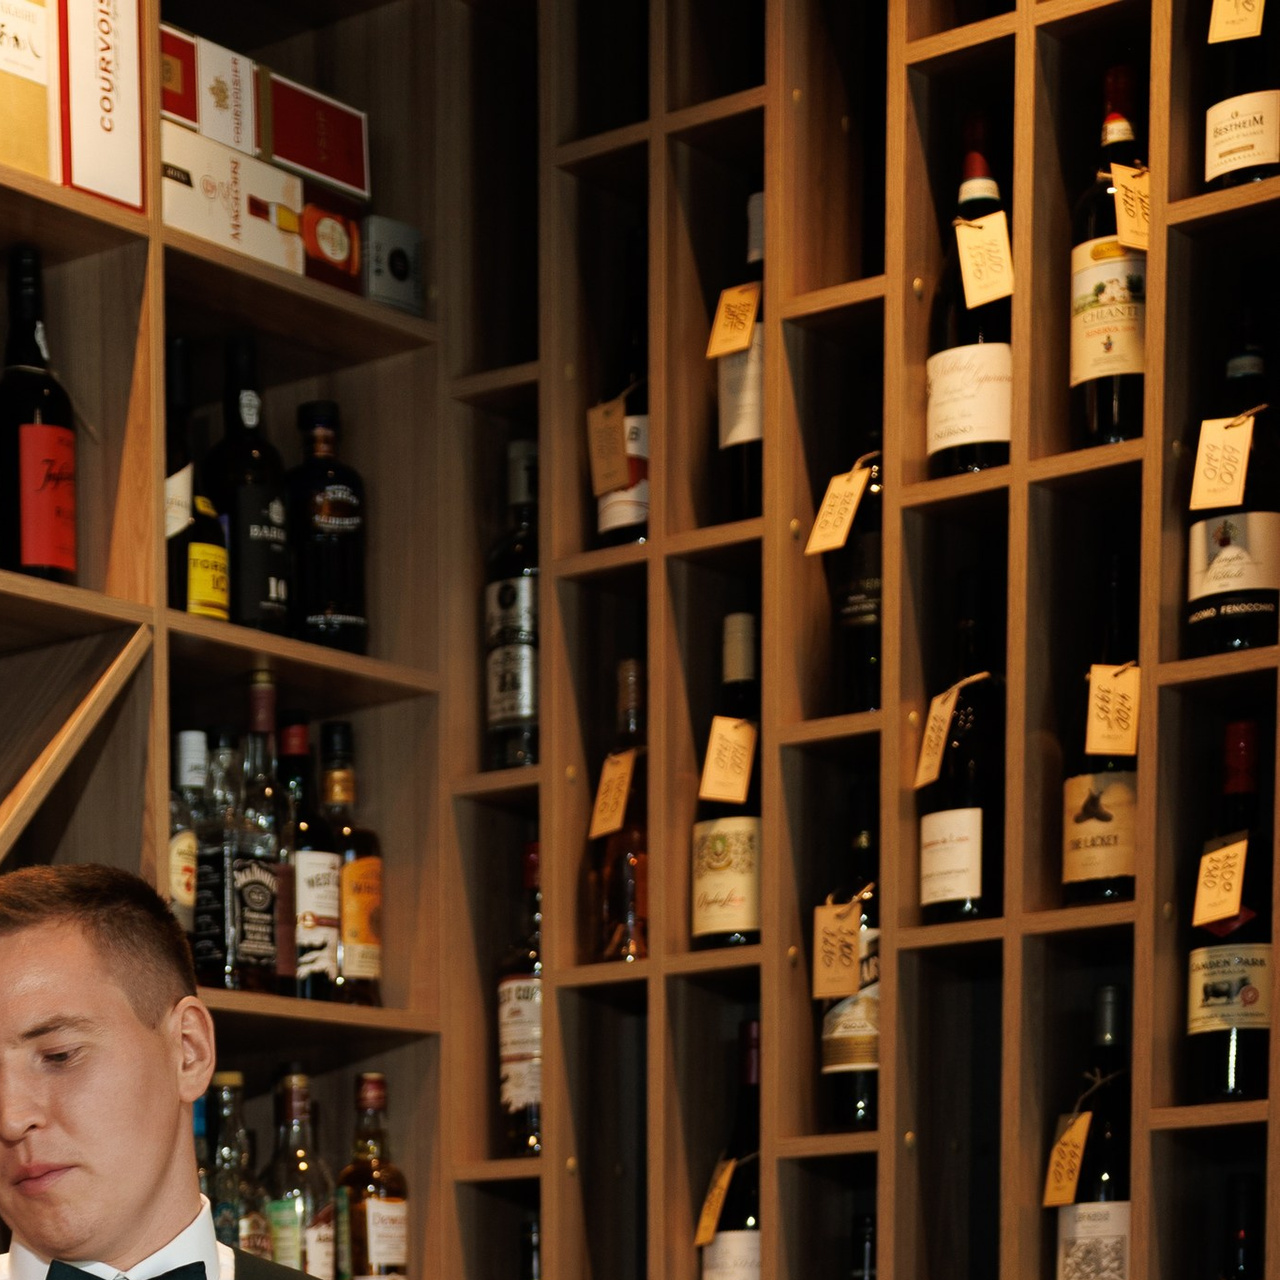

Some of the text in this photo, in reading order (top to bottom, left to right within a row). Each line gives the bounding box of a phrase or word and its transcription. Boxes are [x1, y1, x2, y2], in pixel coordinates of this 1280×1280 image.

[97, 0, 115, 133] COURVOIS
[1213, 115, 1264, 138] BESTHEIM
[1082, 306, 1138, 324] CHIANTI
[1084, 834, 1119, 848] LACKEY
